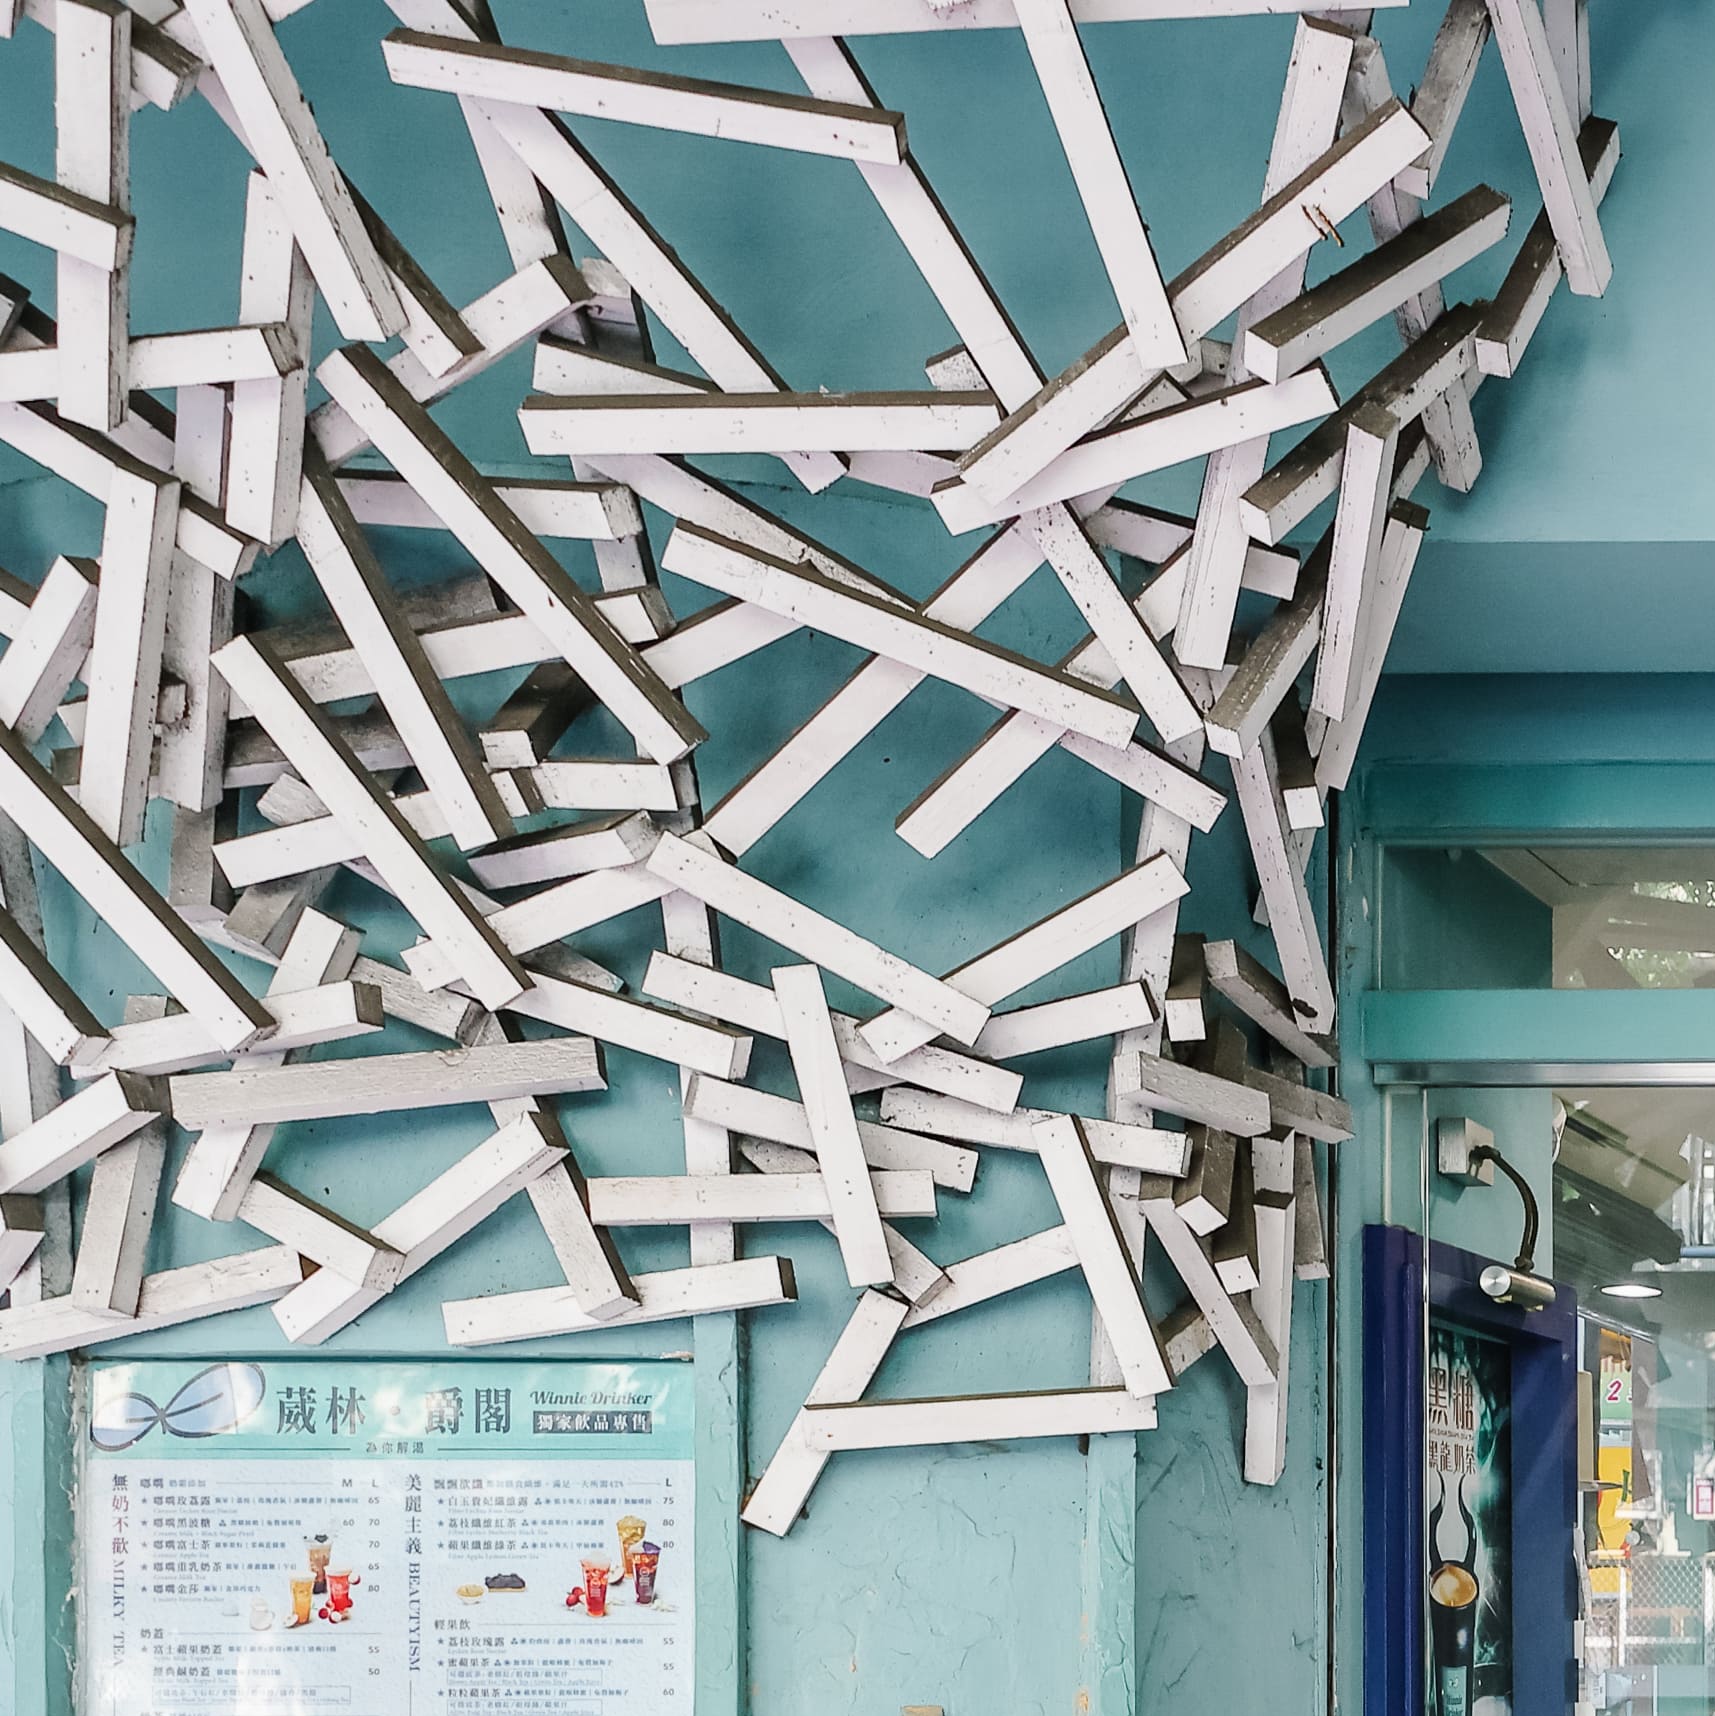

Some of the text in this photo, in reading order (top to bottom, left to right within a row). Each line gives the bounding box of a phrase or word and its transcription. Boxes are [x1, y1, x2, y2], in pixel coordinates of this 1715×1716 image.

[529, 1390, 652, 1405] Winnie Drinker
[536, 1414, 648, 1431] 獨家飲品專售
[342, 1479, 378, 1488] M L
[665, 1479, 673, 1488] L
[368, 1496, 380, 1505] 65
[663, 1497, 675, 1505] 75
[111, 1473, 129, 1555] 無奶不歡
[405, 1473, 422, 1555] 美麗主義
[342, 1518, 380, 1527] 60 70
[663, 1519, 675, 1527] 80
[368, 1541, 380, 1549] 70
[663, 1541, 675, 1549] 80
[368, 1562, 380, 1571] 65
[113, 1559, 125, 1623] MILKY
[368, 1584, 380, 1593] 80
[408, 1562, 421, 1672] BEAUTYISM
[663, 1637, 675, 1646] 55
[368, 1645, 380, 1654] 55
[663, 1662, 675, 1671] 55
[368, 1667, 380, 1676] 50
[663, 1688, 675, 1696] 60
